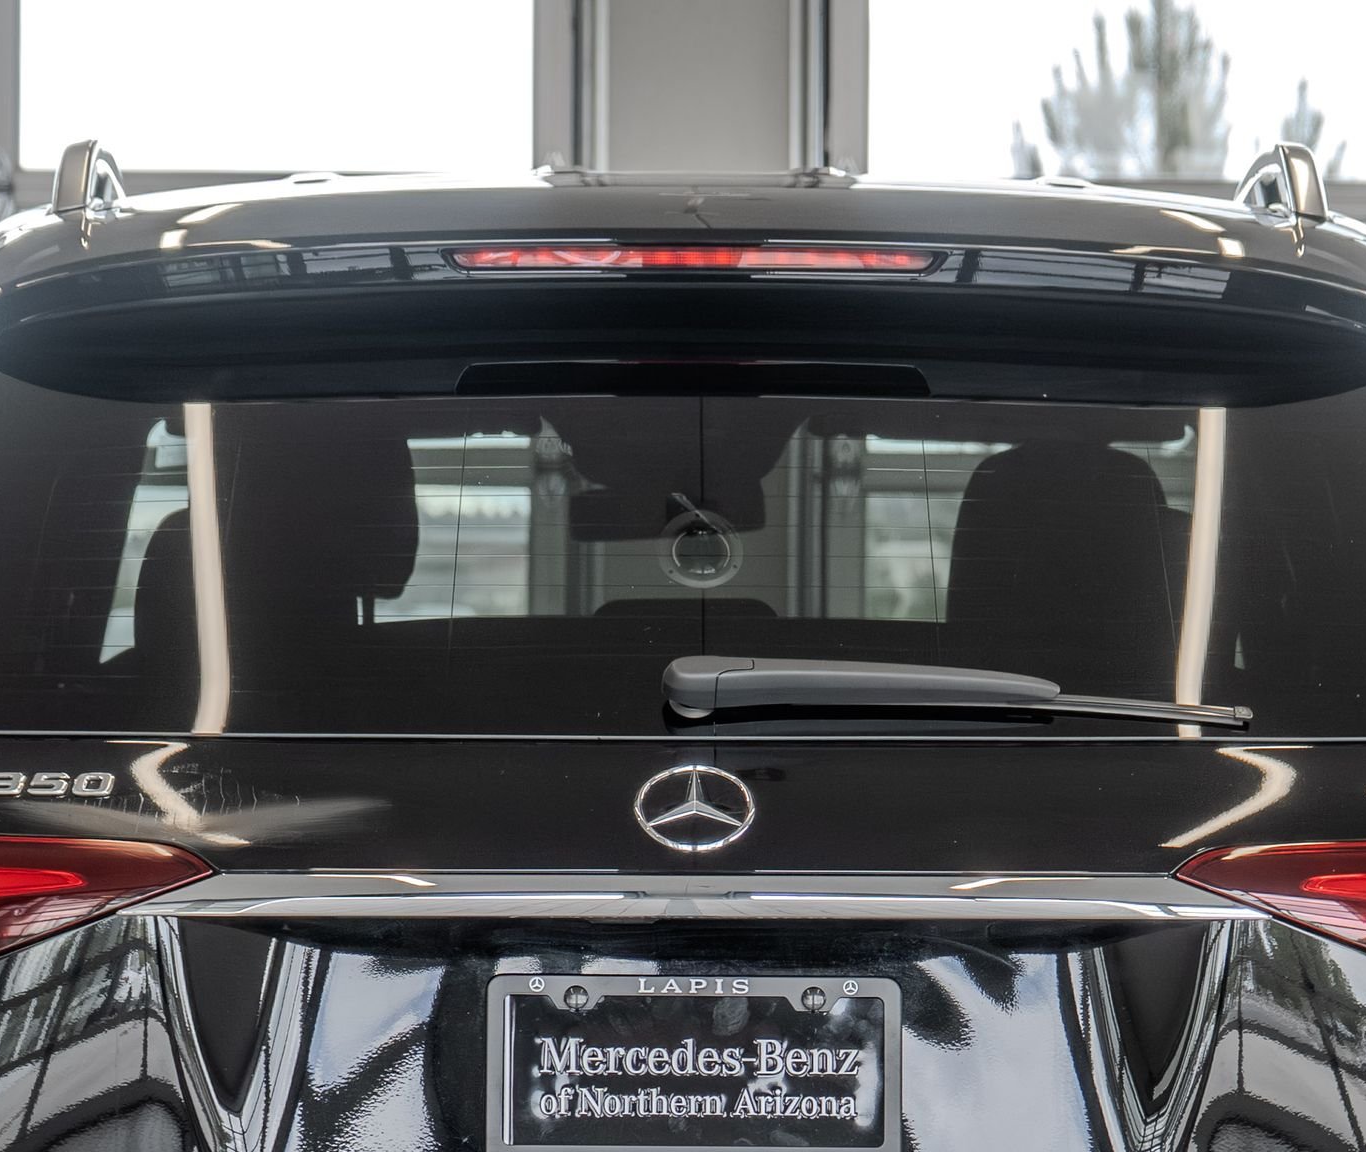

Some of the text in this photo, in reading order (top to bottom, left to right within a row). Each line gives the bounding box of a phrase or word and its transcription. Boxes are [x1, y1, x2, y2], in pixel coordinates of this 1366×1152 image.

[637, 977, 751, 994] LAPIS
[539, 1037, 859, 1077] Mercedes-Benz
[539, 1087, 857, 1117] of Northern Arizona
